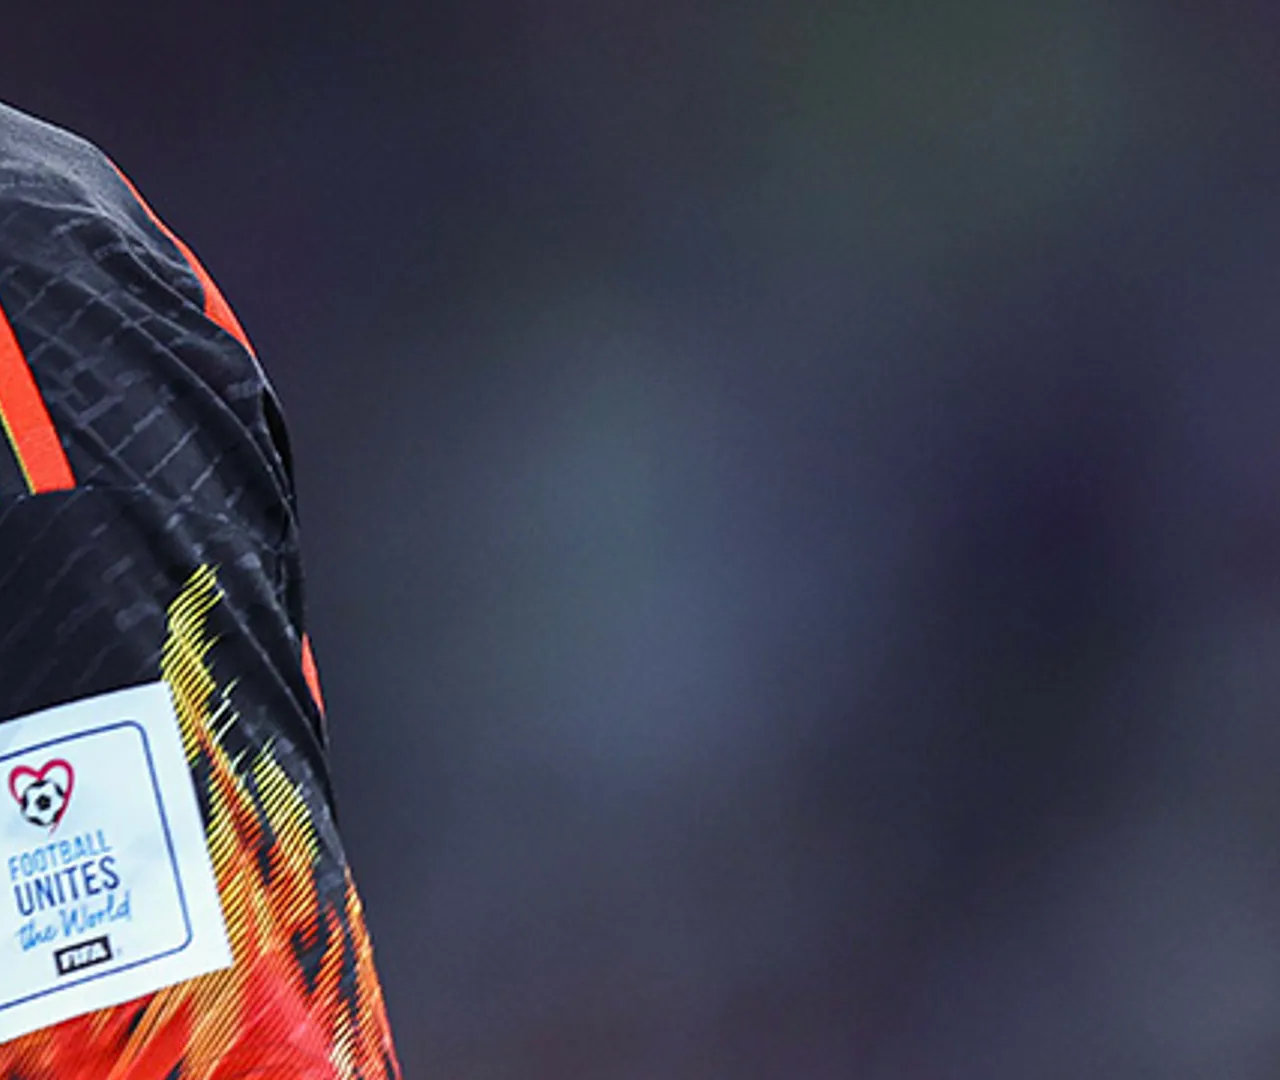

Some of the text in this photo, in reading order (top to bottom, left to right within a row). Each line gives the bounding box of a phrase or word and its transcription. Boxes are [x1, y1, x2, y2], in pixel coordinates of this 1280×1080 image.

[8, 829, 113, 881] FOOTBALL
[14, 855, 121, 917] UNITES
[15, 889, 132, 952] the World
